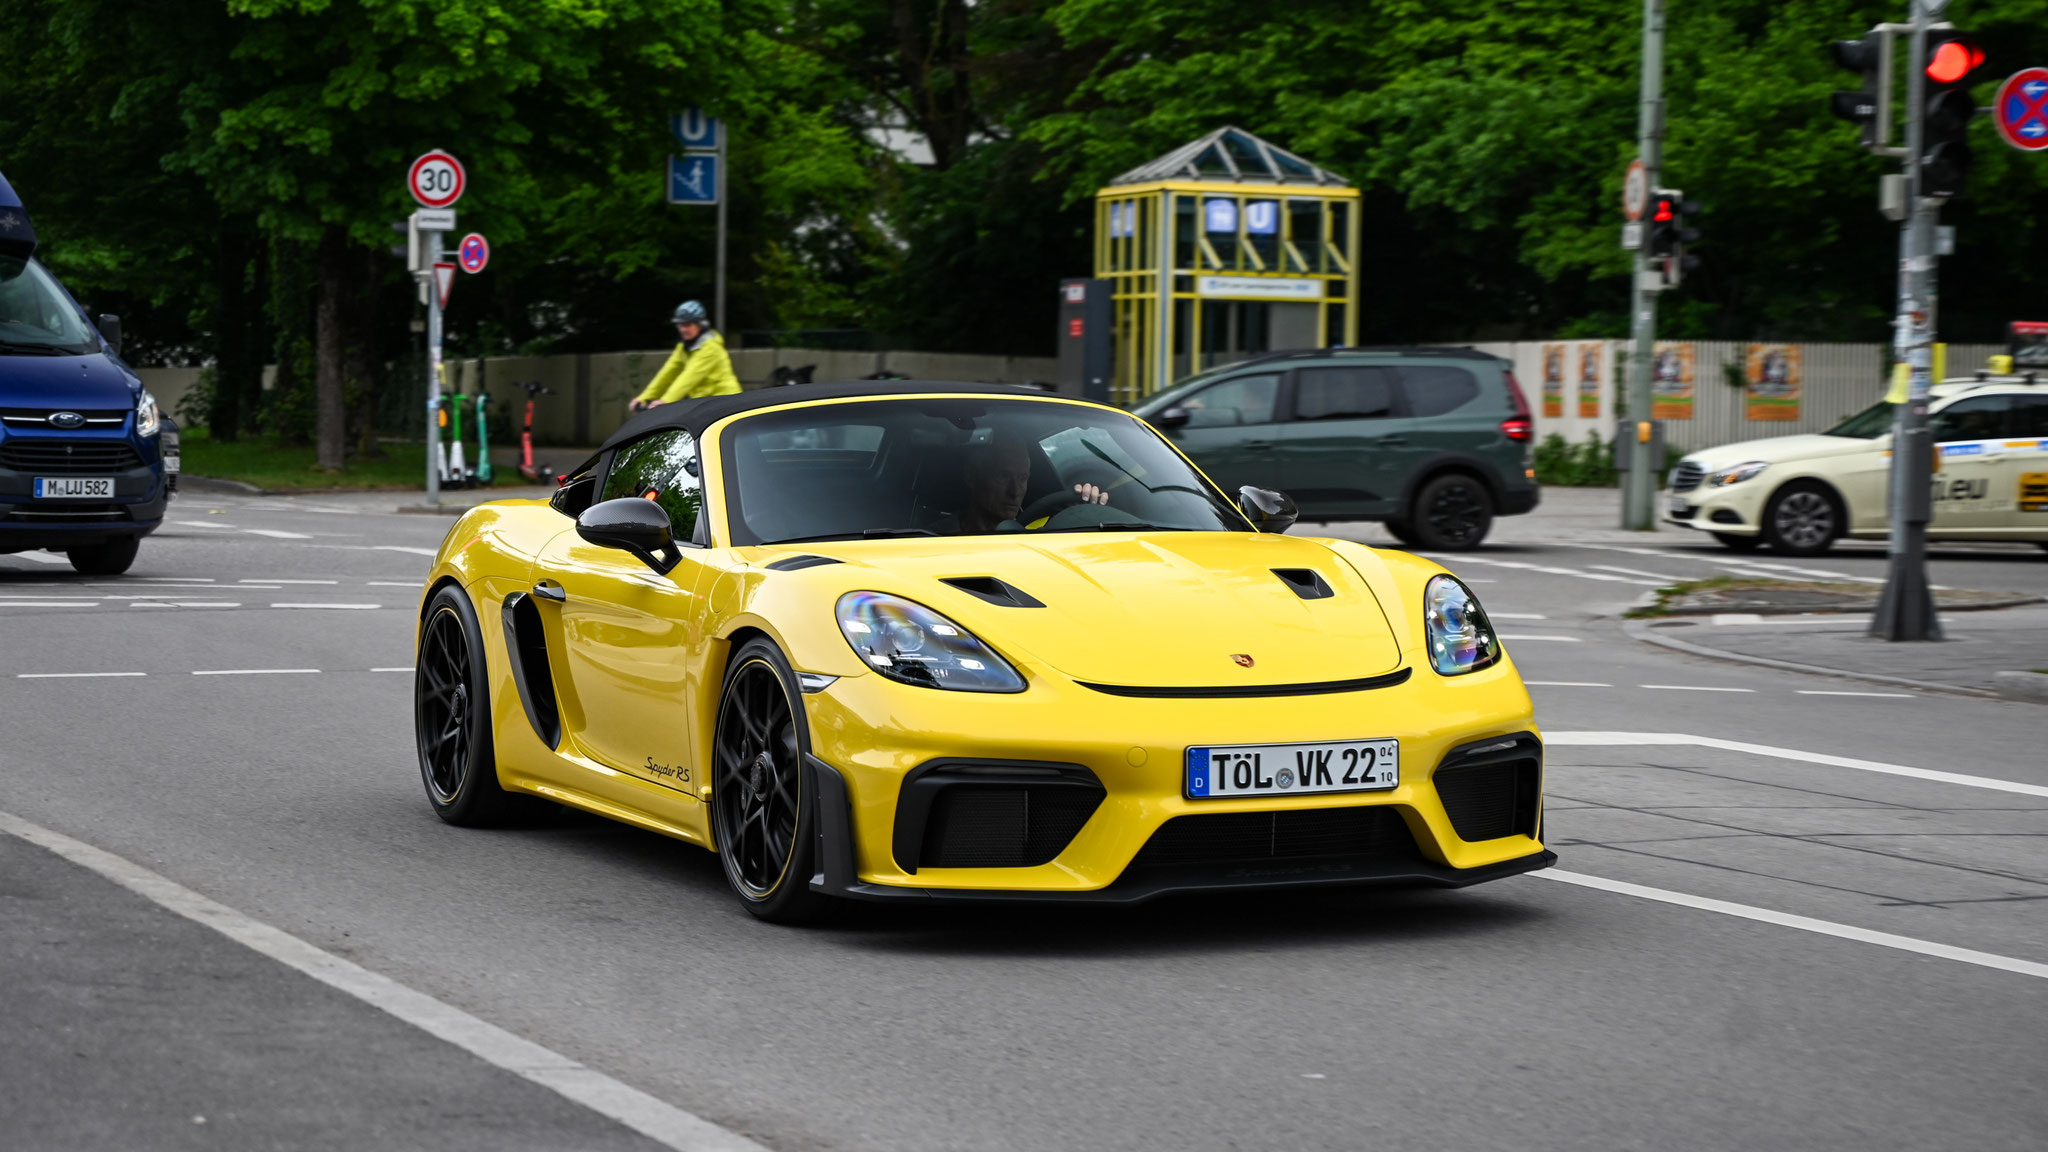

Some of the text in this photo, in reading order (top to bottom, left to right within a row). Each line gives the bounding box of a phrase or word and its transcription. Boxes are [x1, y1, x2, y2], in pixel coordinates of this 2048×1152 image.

[681, 106, 707, 141] U
[421, 168, 452, 192] 30
[1247, 201, 1270, 229] U
[48, 480, 57, 495] M
[65, 480, 83, 495] LU
[85, 480, 109, 495] 582
[1380, 746, 1393, 757] 04
[644, 756, 690, 782] Spyder RS
[1212, 747, 1376, 790] TÖL VK 22
[1381, 771, 1393, 782] 10
[1195, 777, 1204, 788] D
